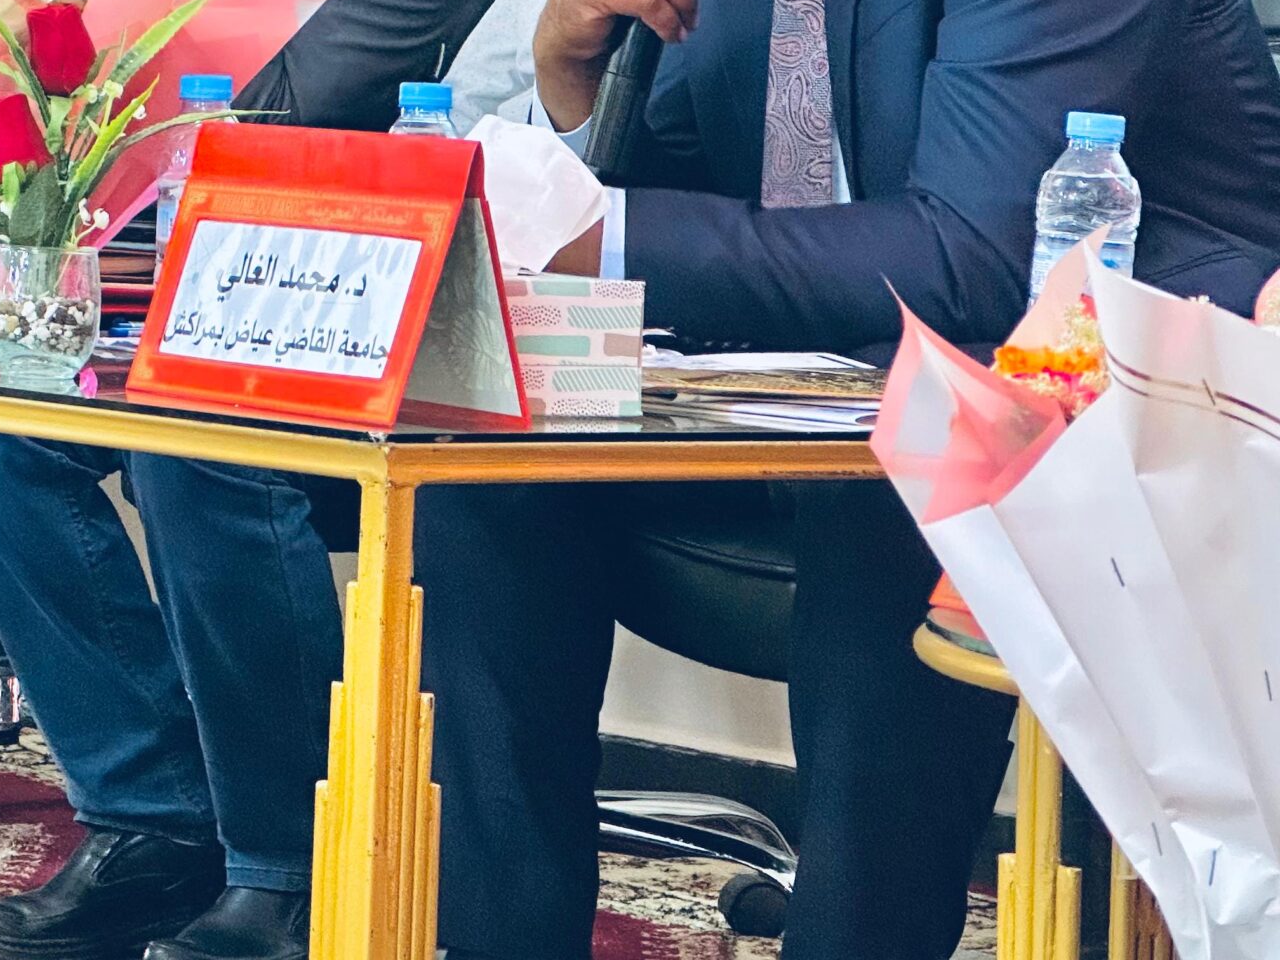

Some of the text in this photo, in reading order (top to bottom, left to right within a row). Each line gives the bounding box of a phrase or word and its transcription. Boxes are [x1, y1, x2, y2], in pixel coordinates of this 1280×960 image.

[217, 251, 279, 303] الغالي
[278, 264, 340, 293] محمد
[163, 309, 389, 368] جامعة القاضي عياض بمراكش
